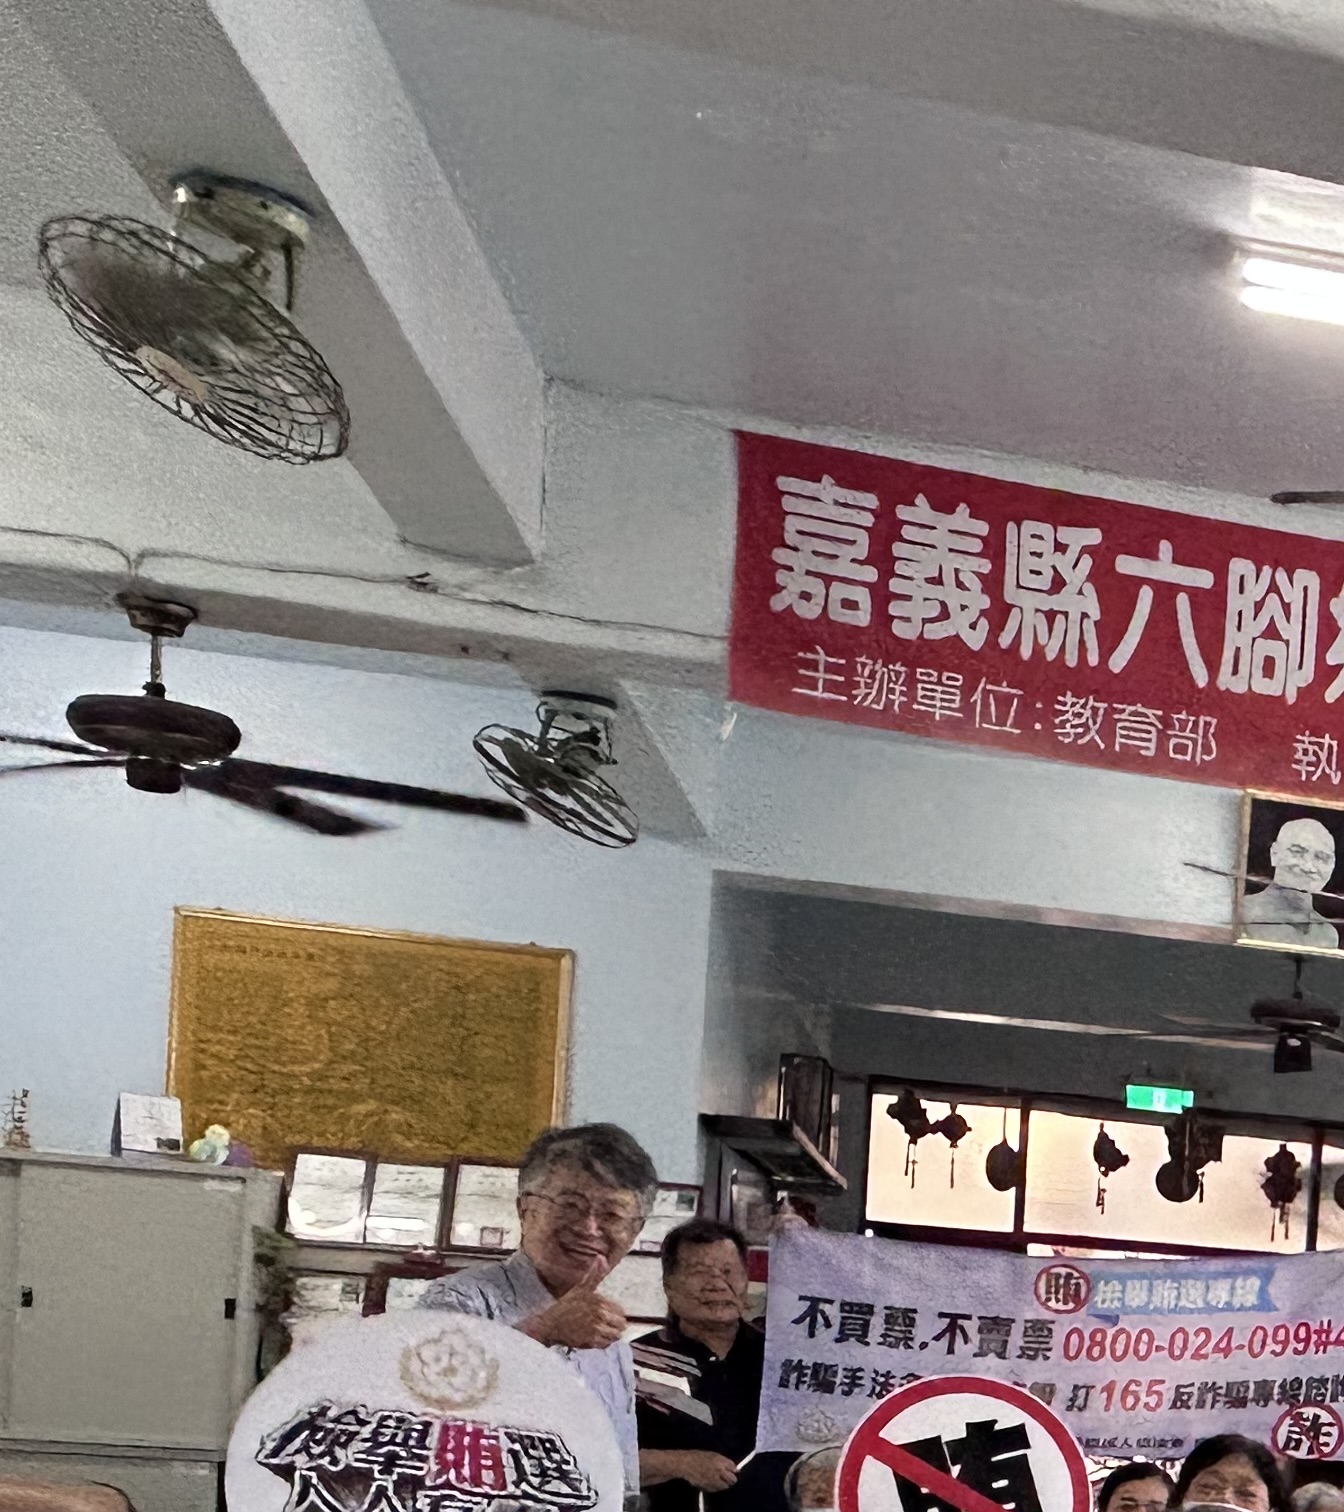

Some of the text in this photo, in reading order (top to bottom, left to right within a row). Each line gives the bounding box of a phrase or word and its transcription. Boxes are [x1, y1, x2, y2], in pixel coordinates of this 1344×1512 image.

[791, 643, 1219, 766] 主辦單位:教育部
